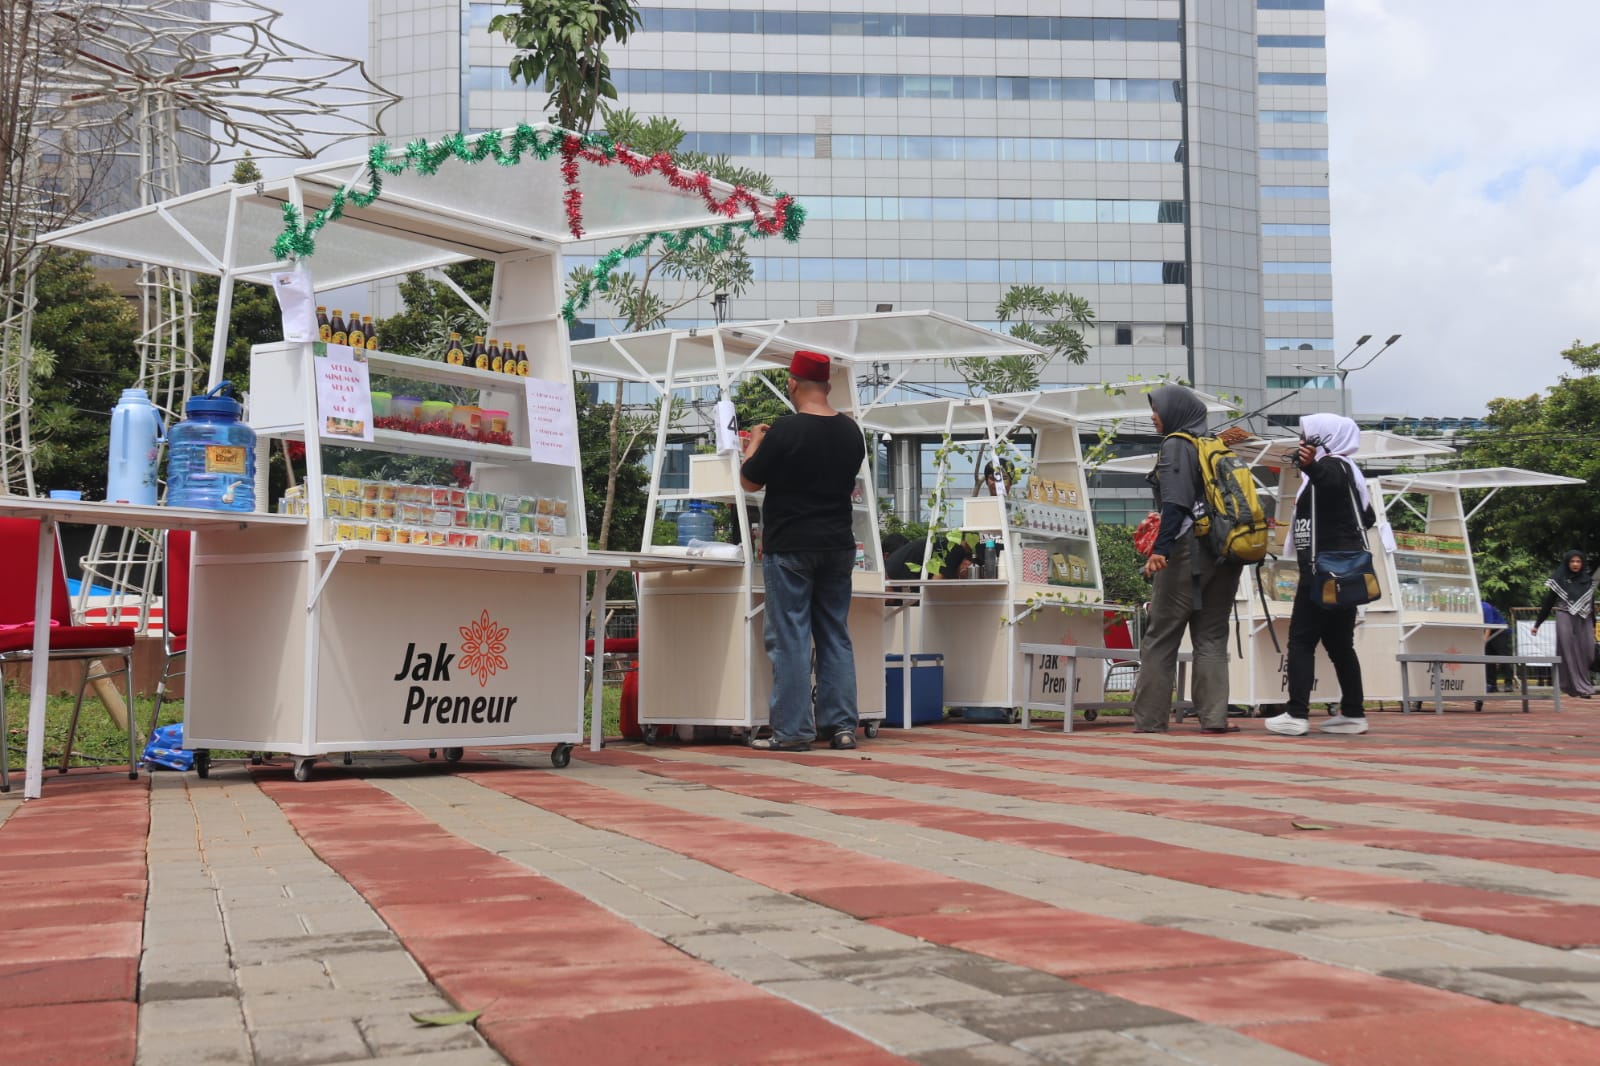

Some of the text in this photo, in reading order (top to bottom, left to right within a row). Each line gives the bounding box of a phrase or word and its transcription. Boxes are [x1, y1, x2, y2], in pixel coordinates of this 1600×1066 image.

[727, 415, 738, 436] 4
[394, 642, 455, 681] Jak
[1039, 654, 1058, 669] Jak
[403, 685, 518, 724] Preneur
